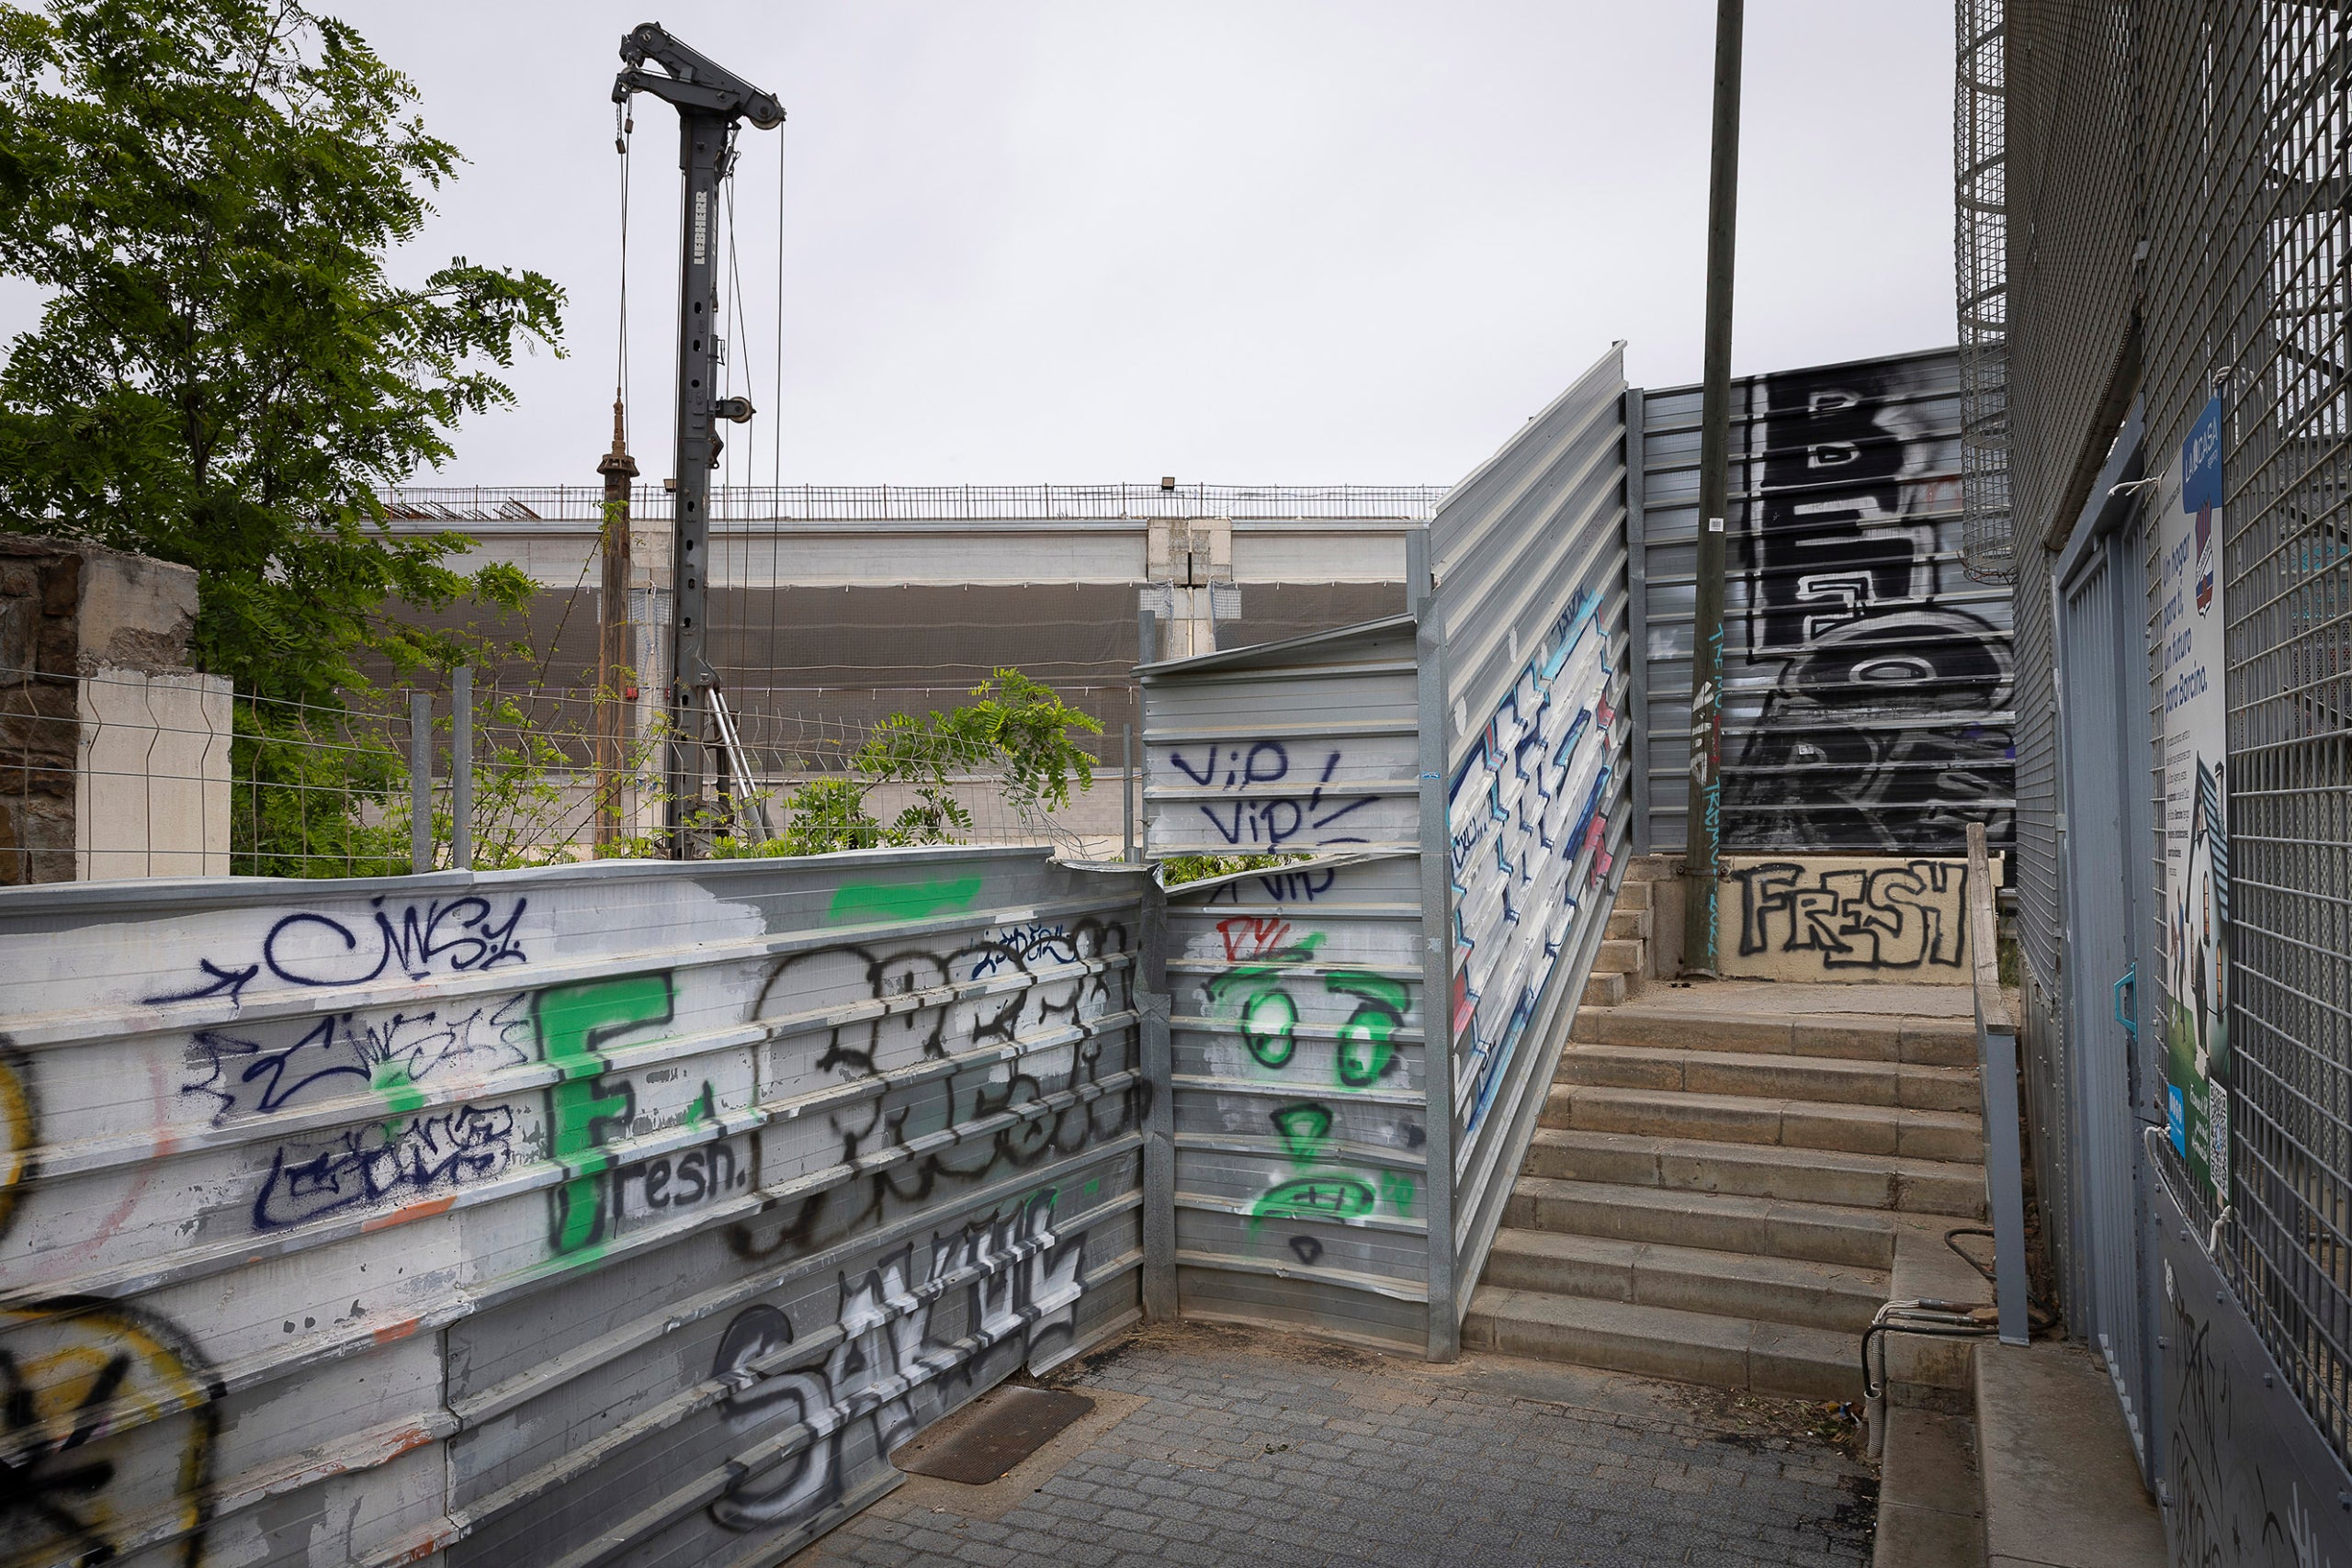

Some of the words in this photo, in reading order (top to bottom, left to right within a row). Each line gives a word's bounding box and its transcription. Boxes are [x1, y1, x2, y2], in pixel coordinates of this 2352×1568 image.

[694, 190, 707, 265] LIEBHERR
[2171, 531, 2190, 578] hogar
[2164, 599, 2177, 638] para
[2172, 626, 2192, 667] futuro
[2165, 683, 2178, 723] para
[2178, 660, 2208, 706] Barcino.
[1731, 859, 1968, 969] FRESH
